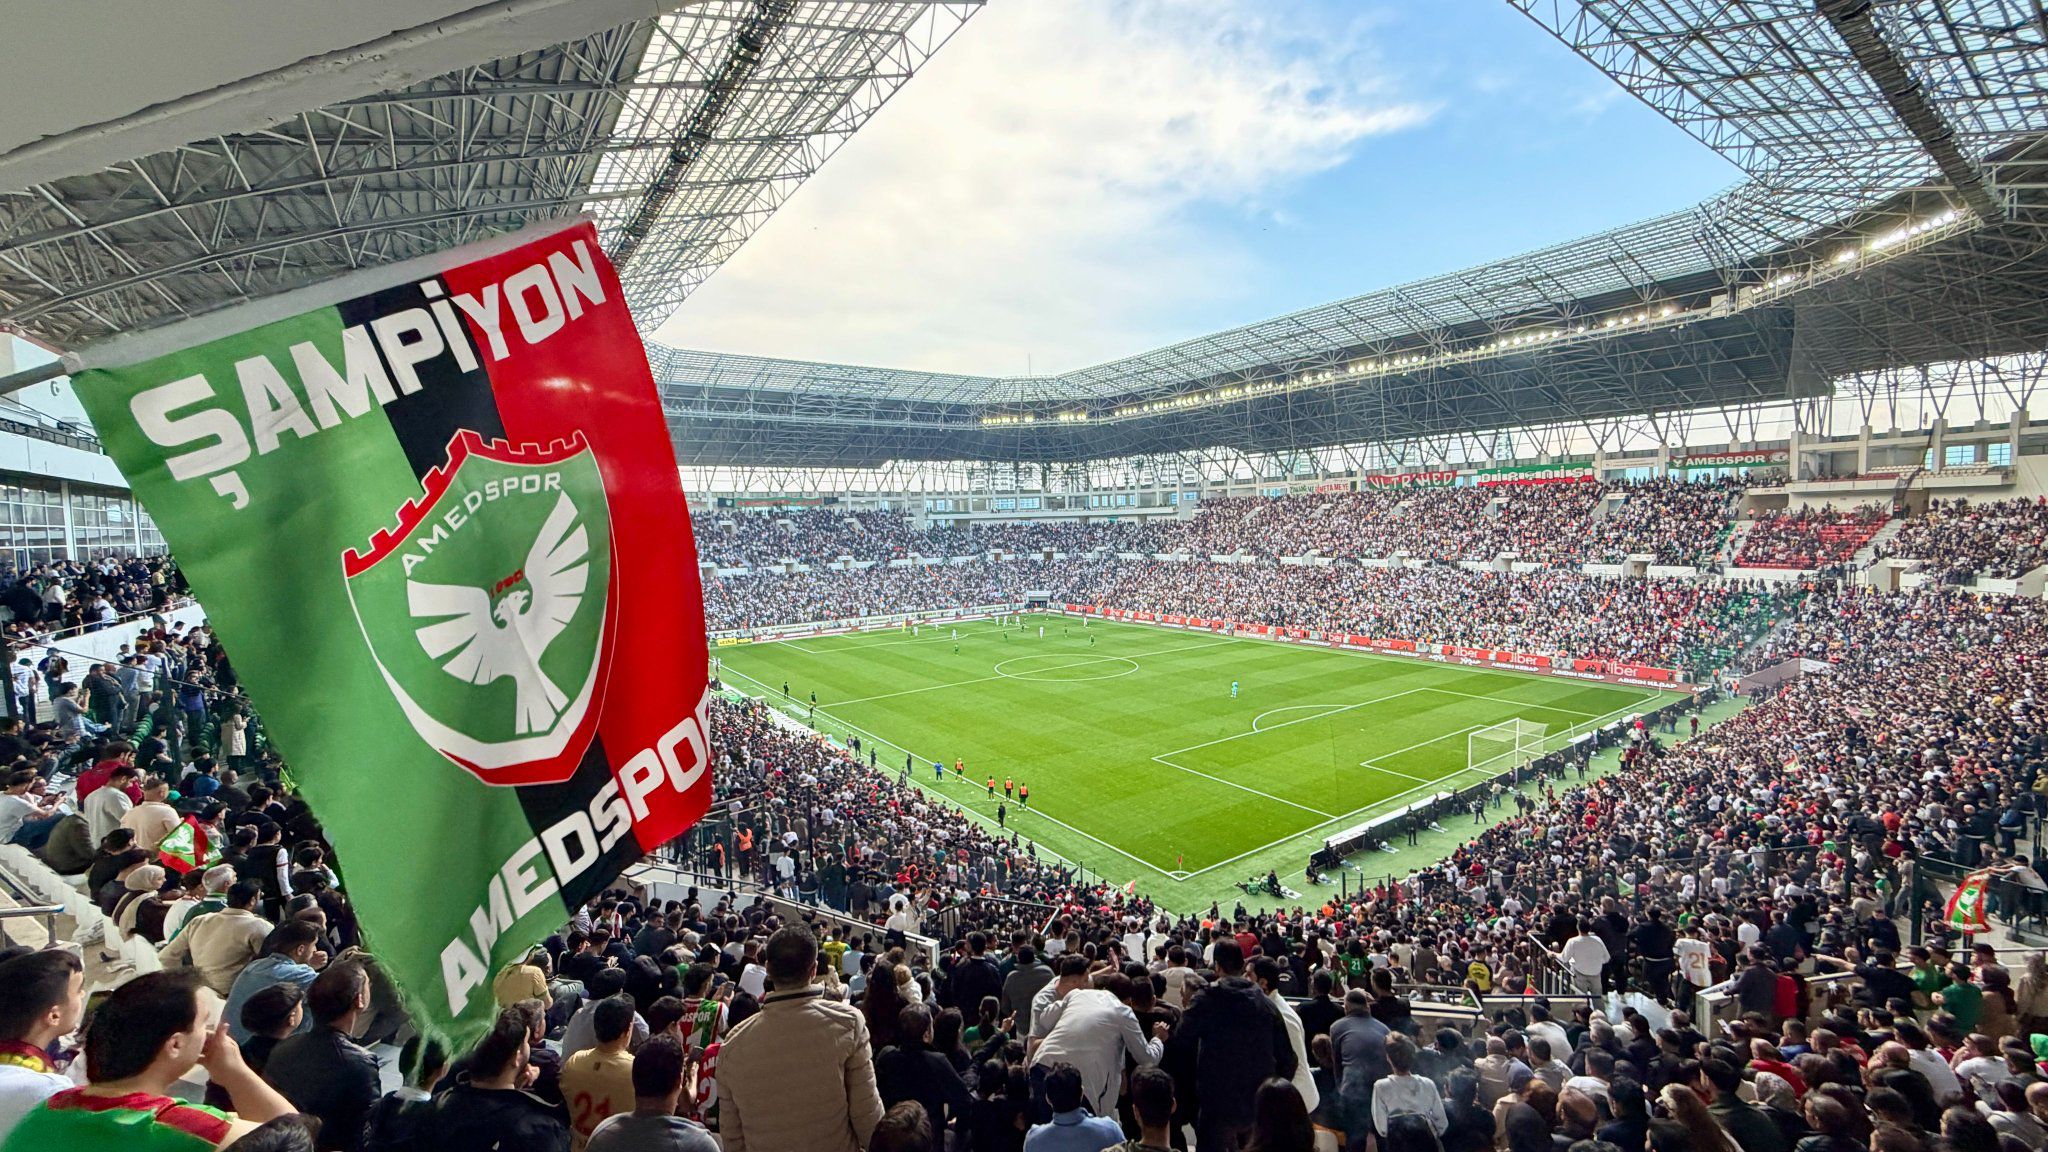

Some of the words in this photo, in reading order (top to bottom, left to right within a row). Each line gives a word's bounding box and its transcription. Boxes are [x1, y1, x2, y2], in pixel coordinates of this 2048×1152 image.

[130, 239, 607, 510] ŞAMPİYON
[1685, 454, 1766, 467] AMEDSPOR
[402, 472, 561, 577] AMEDSPOR
[1351, 960, 1361, 970] 21
[1689, 952, 1705, 969] 21
